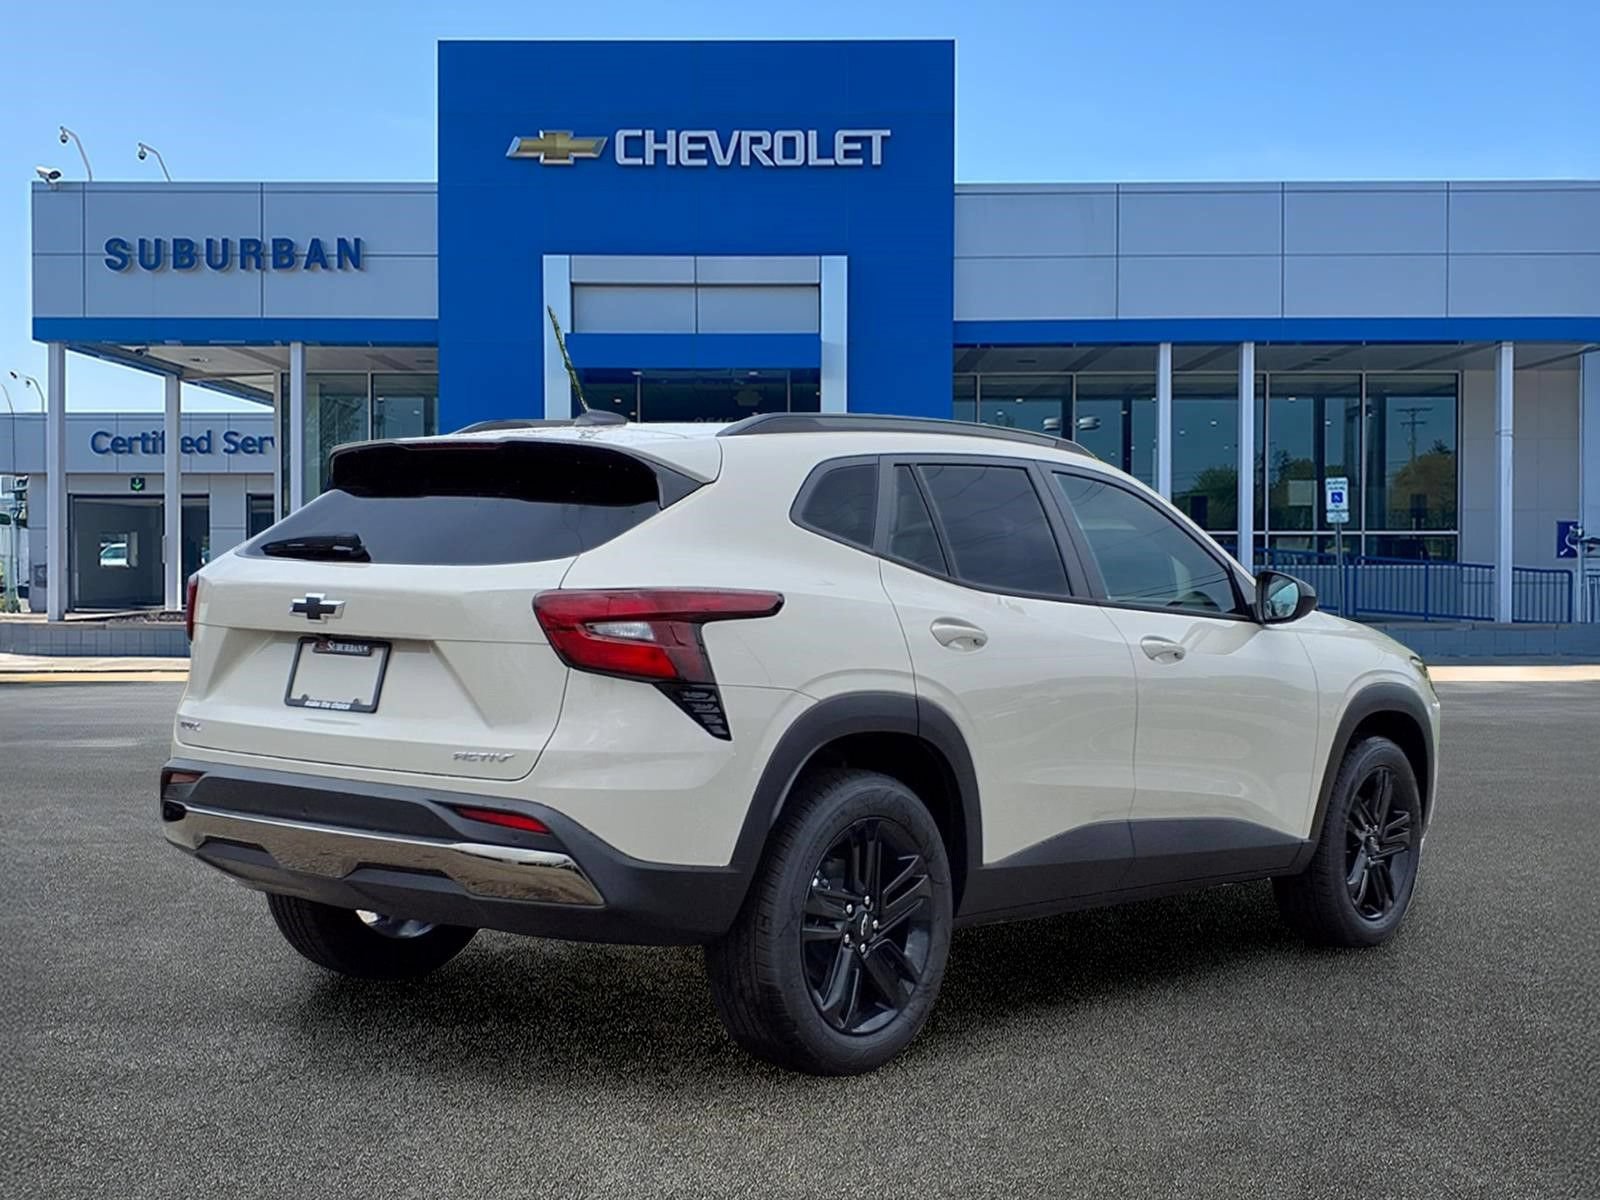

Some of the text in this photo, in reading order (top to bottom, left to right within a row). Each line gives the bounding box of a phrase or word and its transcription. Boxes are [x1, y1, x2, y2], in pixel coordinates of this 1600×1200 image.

[614, 128, 892, 168] CHEVROLET
[104, 237, 363, 272] SUBURBAN
[90, 430, 213, 455] Certifed
